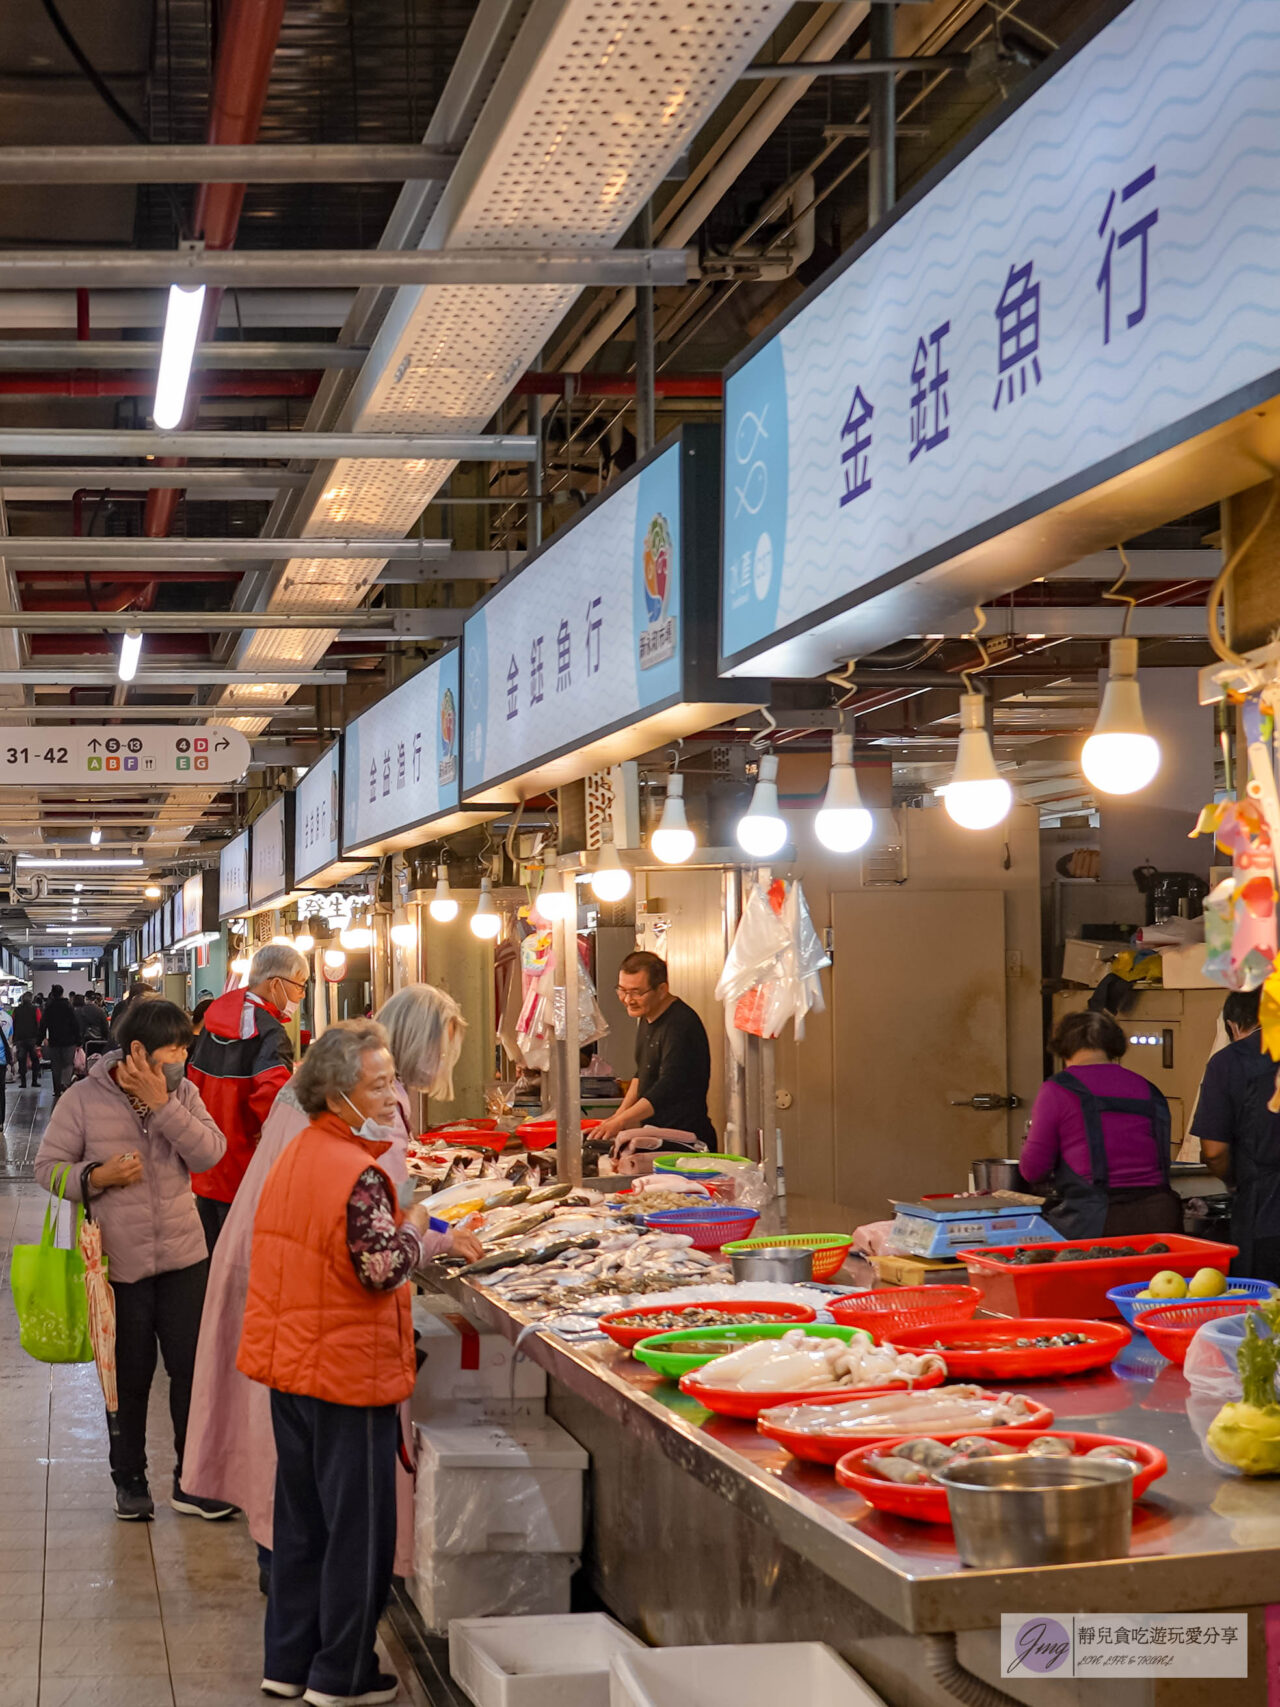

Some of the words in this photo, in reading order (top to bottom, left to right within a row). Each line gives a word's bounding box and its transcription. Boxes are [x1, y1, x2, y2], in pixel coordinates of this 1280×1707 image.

[838, 165, 1159, 508] 金鈺魚行
[506, 596, 603, 721] 金鈺魚行
